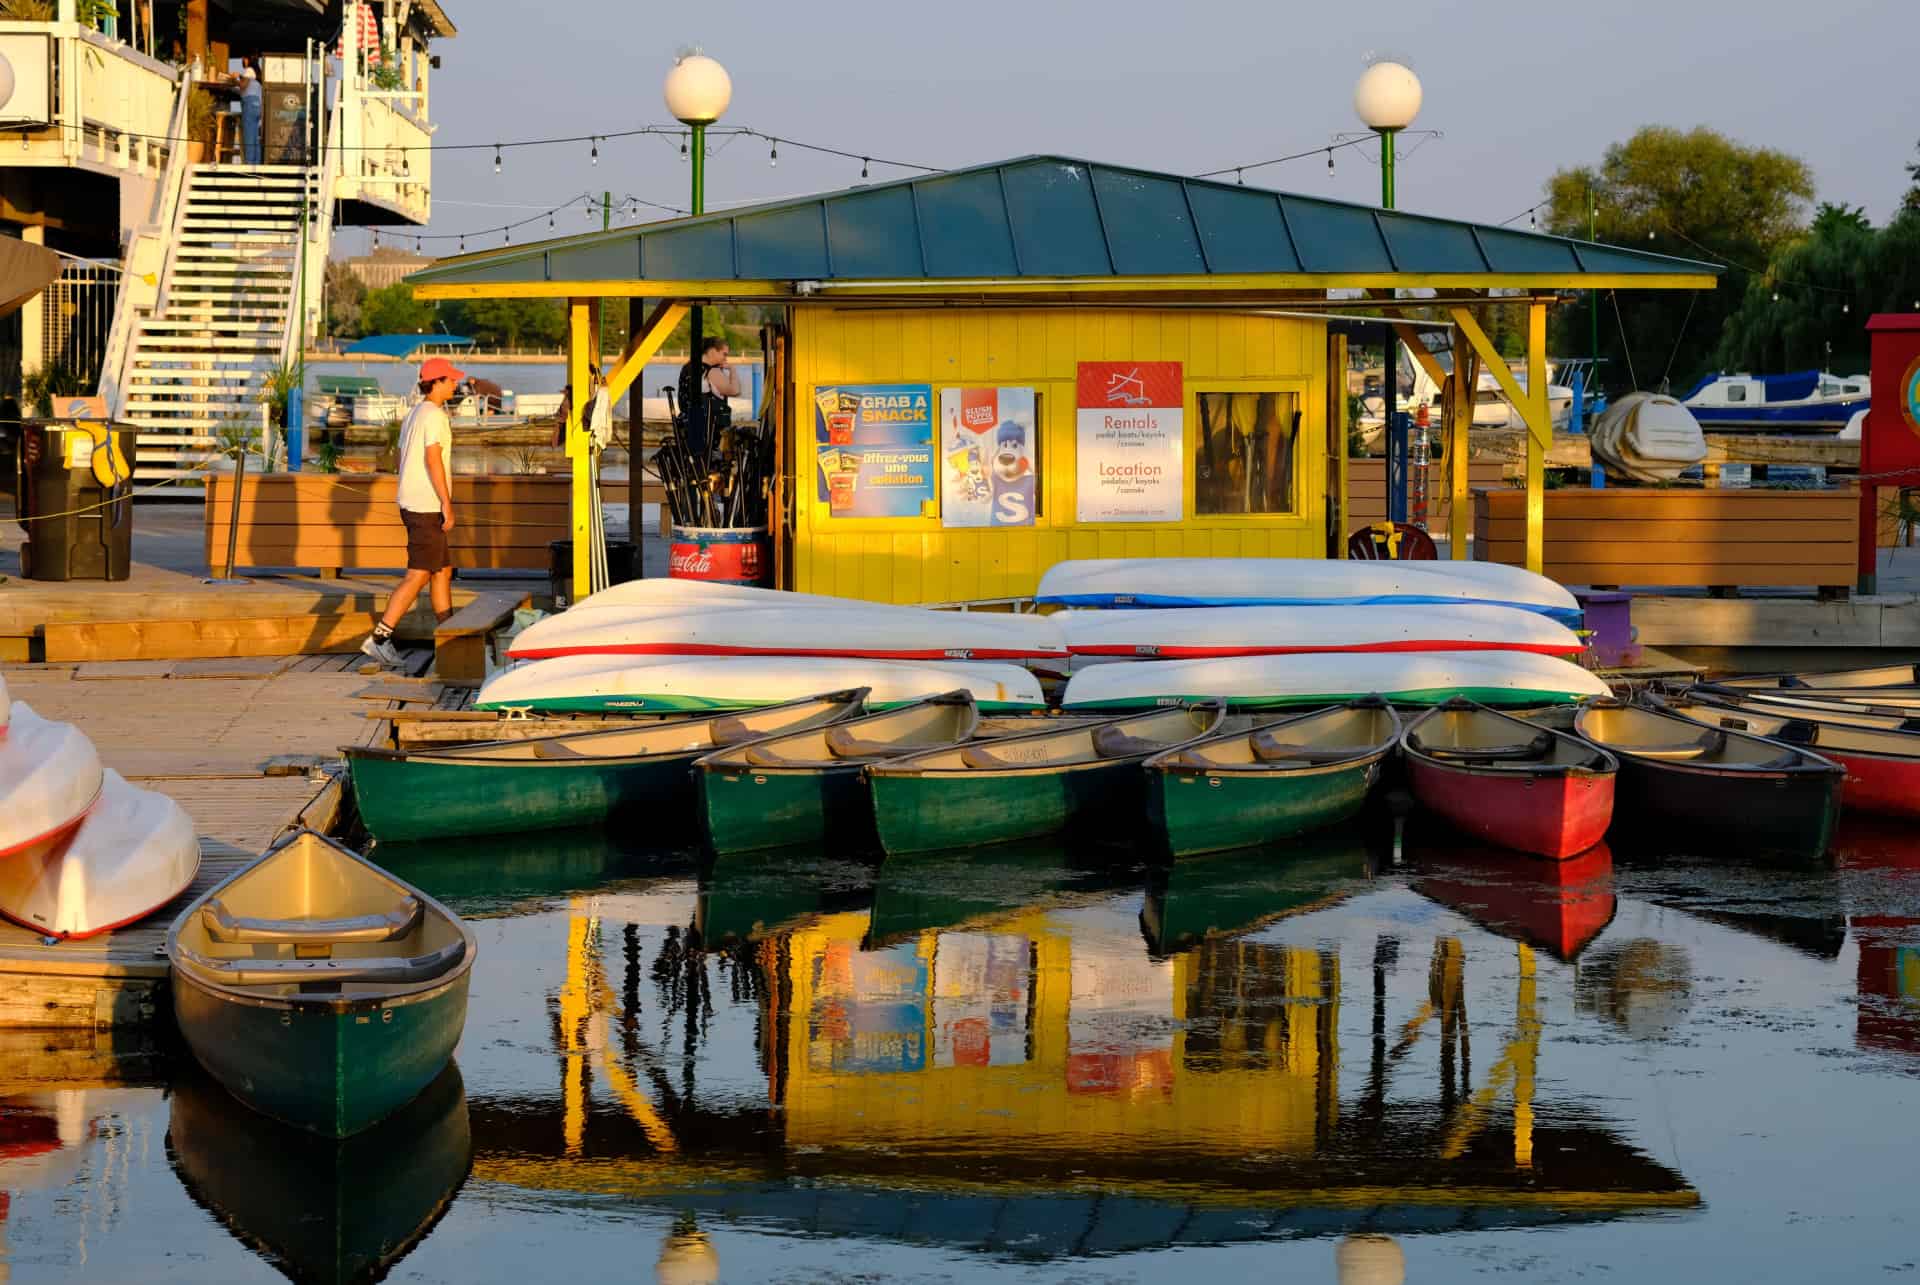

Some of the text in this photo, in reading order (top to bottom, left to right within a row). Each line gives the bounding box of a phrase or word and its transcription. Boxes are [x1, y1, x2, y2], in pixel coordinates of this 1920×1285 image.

[861, 396, 911, 409] GRAB
[914, 395, 928, 408] A
[861, 409, 928, 422] SNACK
[1104, 413, 1158, 429] Rentals
[884, 463, 908, 473] une
[1099, 463, 1162, 476] Location
[995, 492, 1029, 523] S
